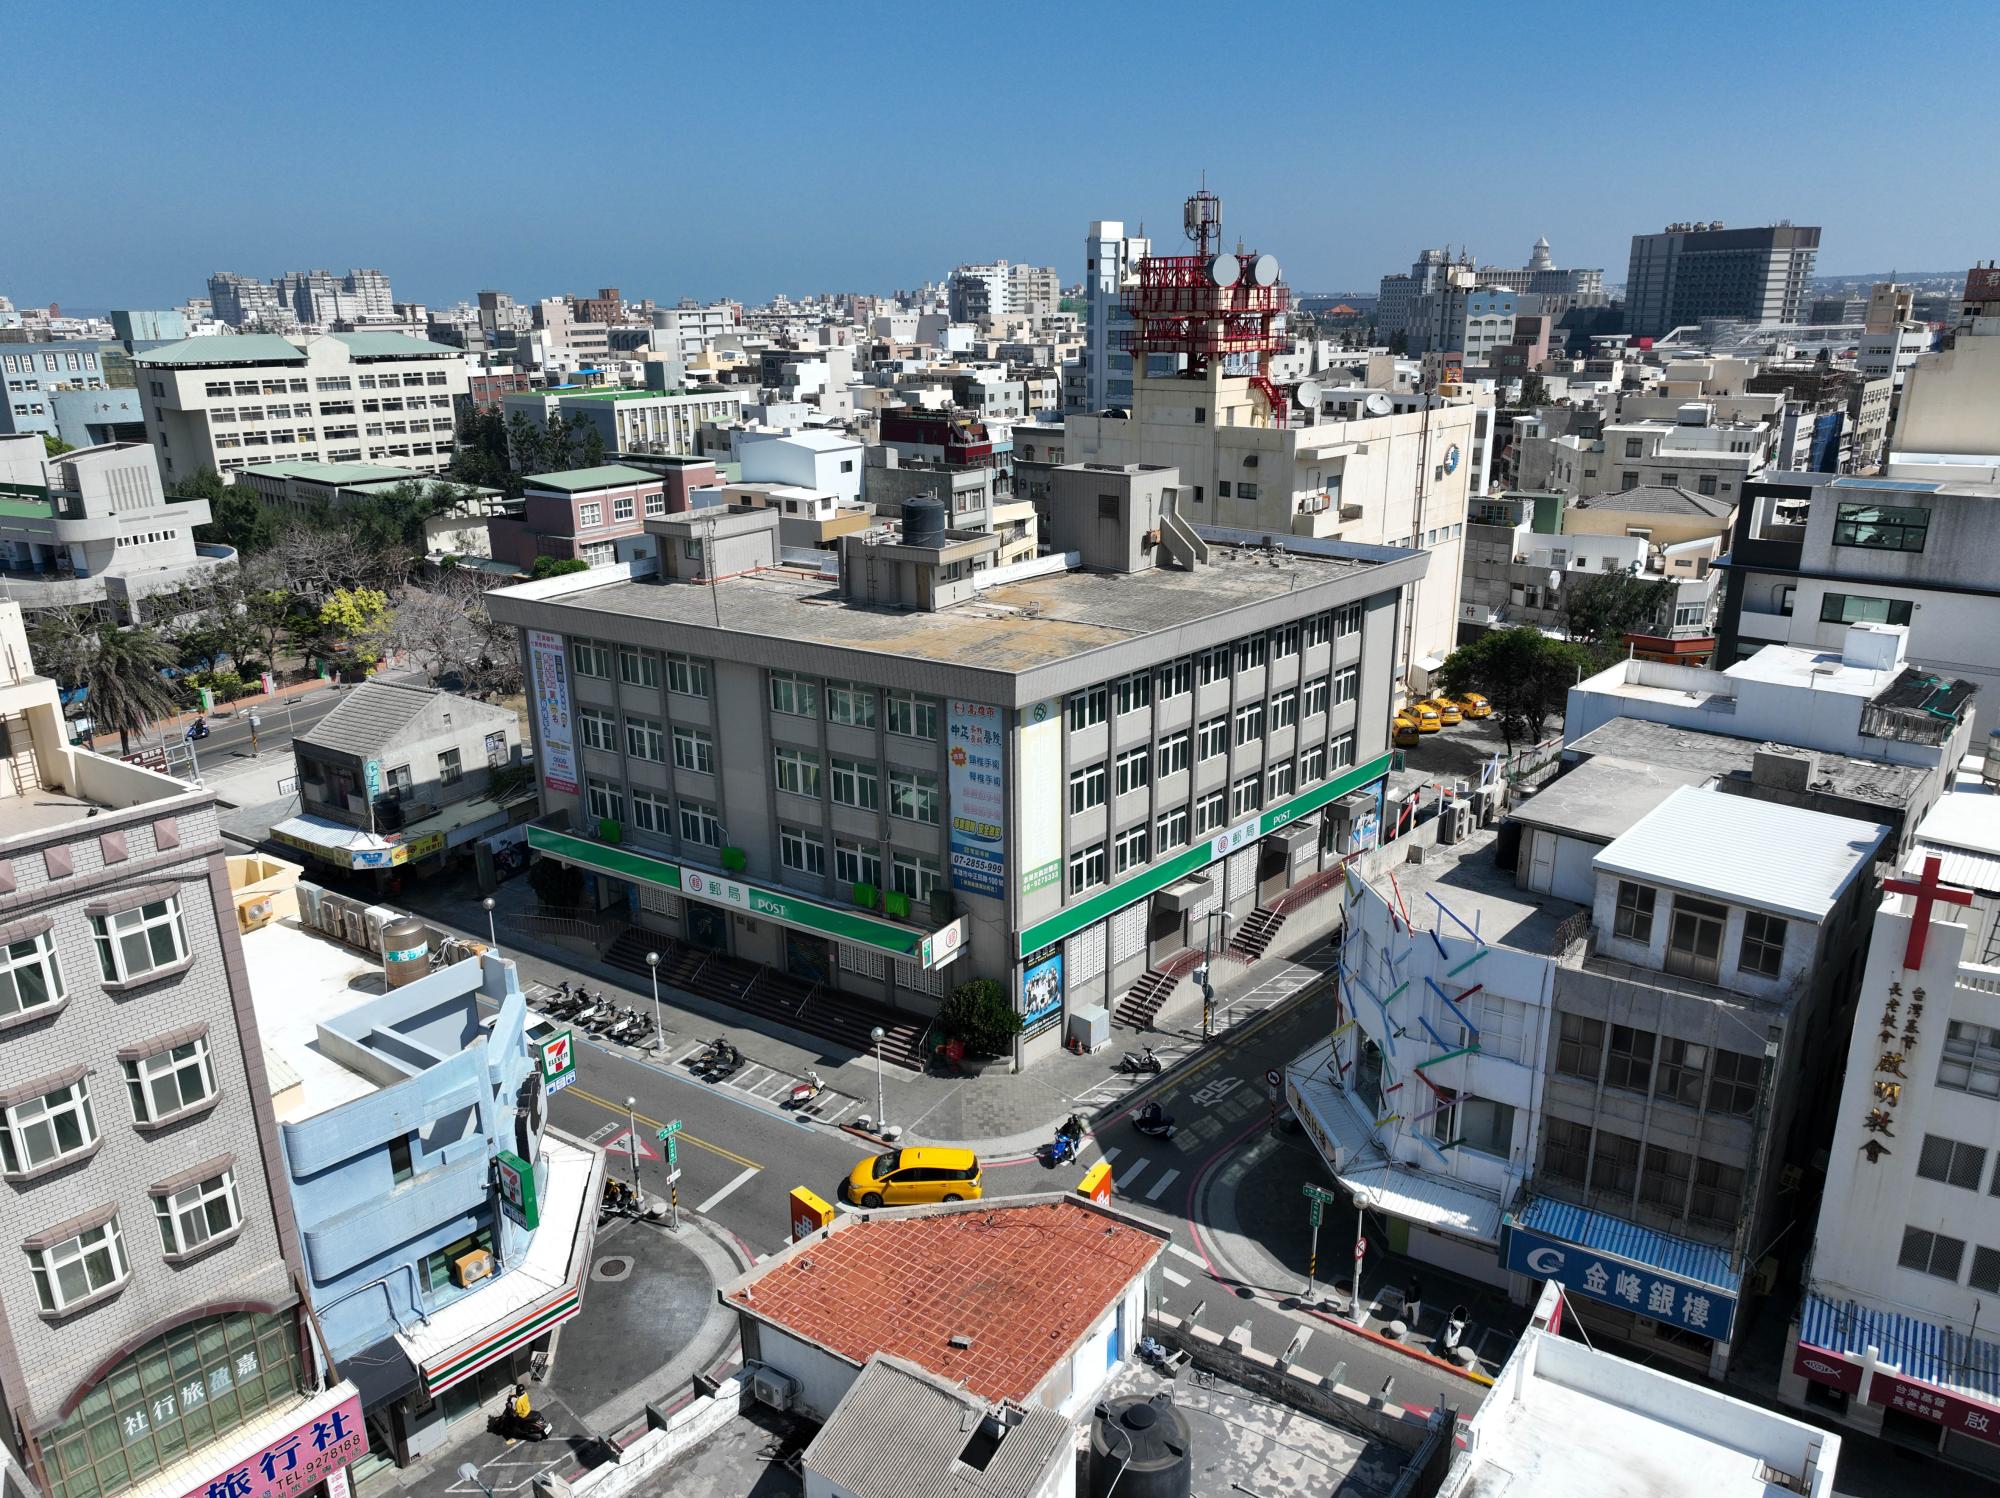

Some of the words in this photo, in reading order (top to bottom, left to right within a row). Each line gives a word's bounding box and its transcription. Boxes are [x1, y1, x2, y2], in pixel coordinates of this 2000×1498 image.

[1273, 809, 1291, 825] POST
[954, 857, 1002, 873] 07-2855-999
[708, 880, 741, 901] 郵局
[758, 899, 785, 915] POST
[1878, 982, 1903, 1044] 長老教會
[1901, 987, 1926, 1052] 台灣基督
[1583, 1261, 1711, 1328] 金峰銀樓
[1892, 1395, 1944, 1420] 長老教會
[1895, 1383, 1947, 1408] 台灣基督
[204, 1411, 354, 1498] 旅行社
[276, 1434, 361, 1490] TEL:9278188
